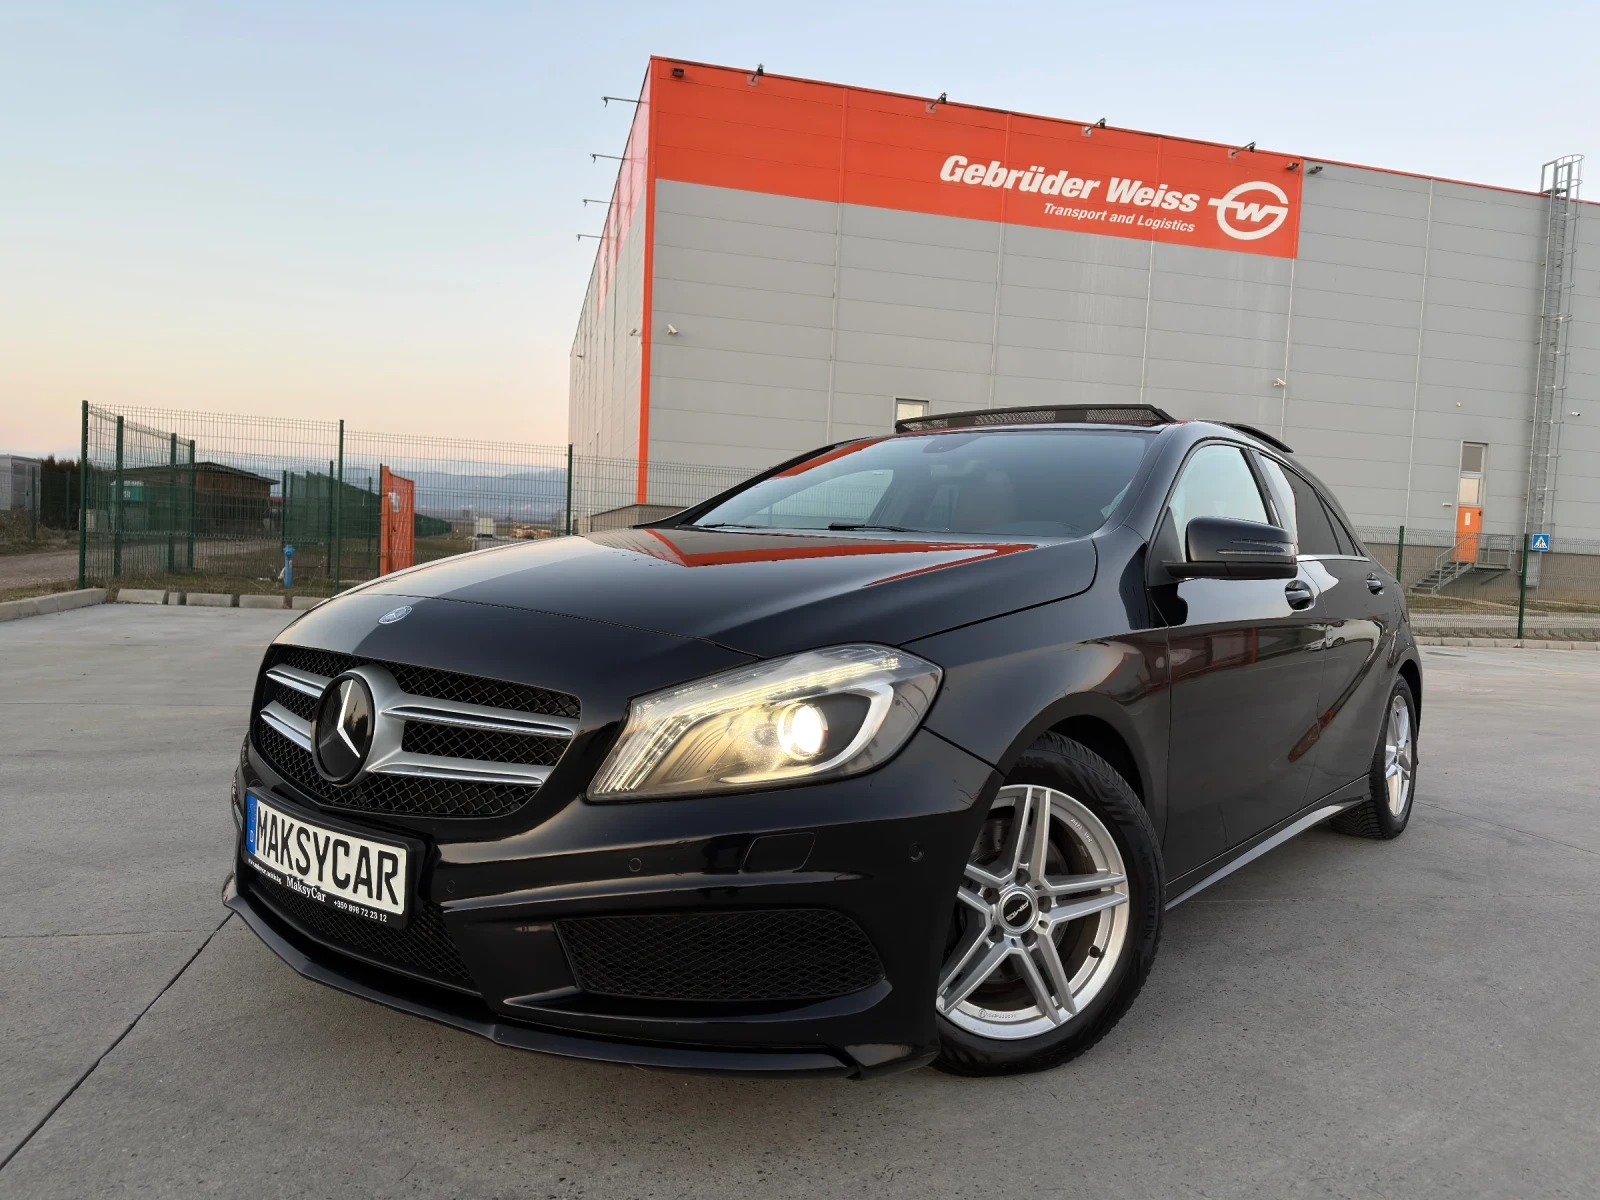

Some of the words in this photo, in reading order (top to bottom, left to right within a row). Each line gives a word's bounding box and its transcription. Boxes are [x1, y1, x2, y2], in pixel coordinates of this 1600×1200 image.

[940, 155, 1100, 199] Gebrüder
[1106, 177, 1200, 212] Weiss
[1044, 203, 1107, 220] Transport
[1109, 213, 1135, 224] and
[1137, 215, 1195, 232] Logistics
[257, 806, 399, 905] MAKSYCAR
[286, 876, 326, 902] MaksyCar
[334, 900, 347, 910] +359
[348, 904, 359, 914] 898
[360, 908, 368, 917] 72
[369, 911, 378, 920] 23
[379, 913, 387, 922] 12
